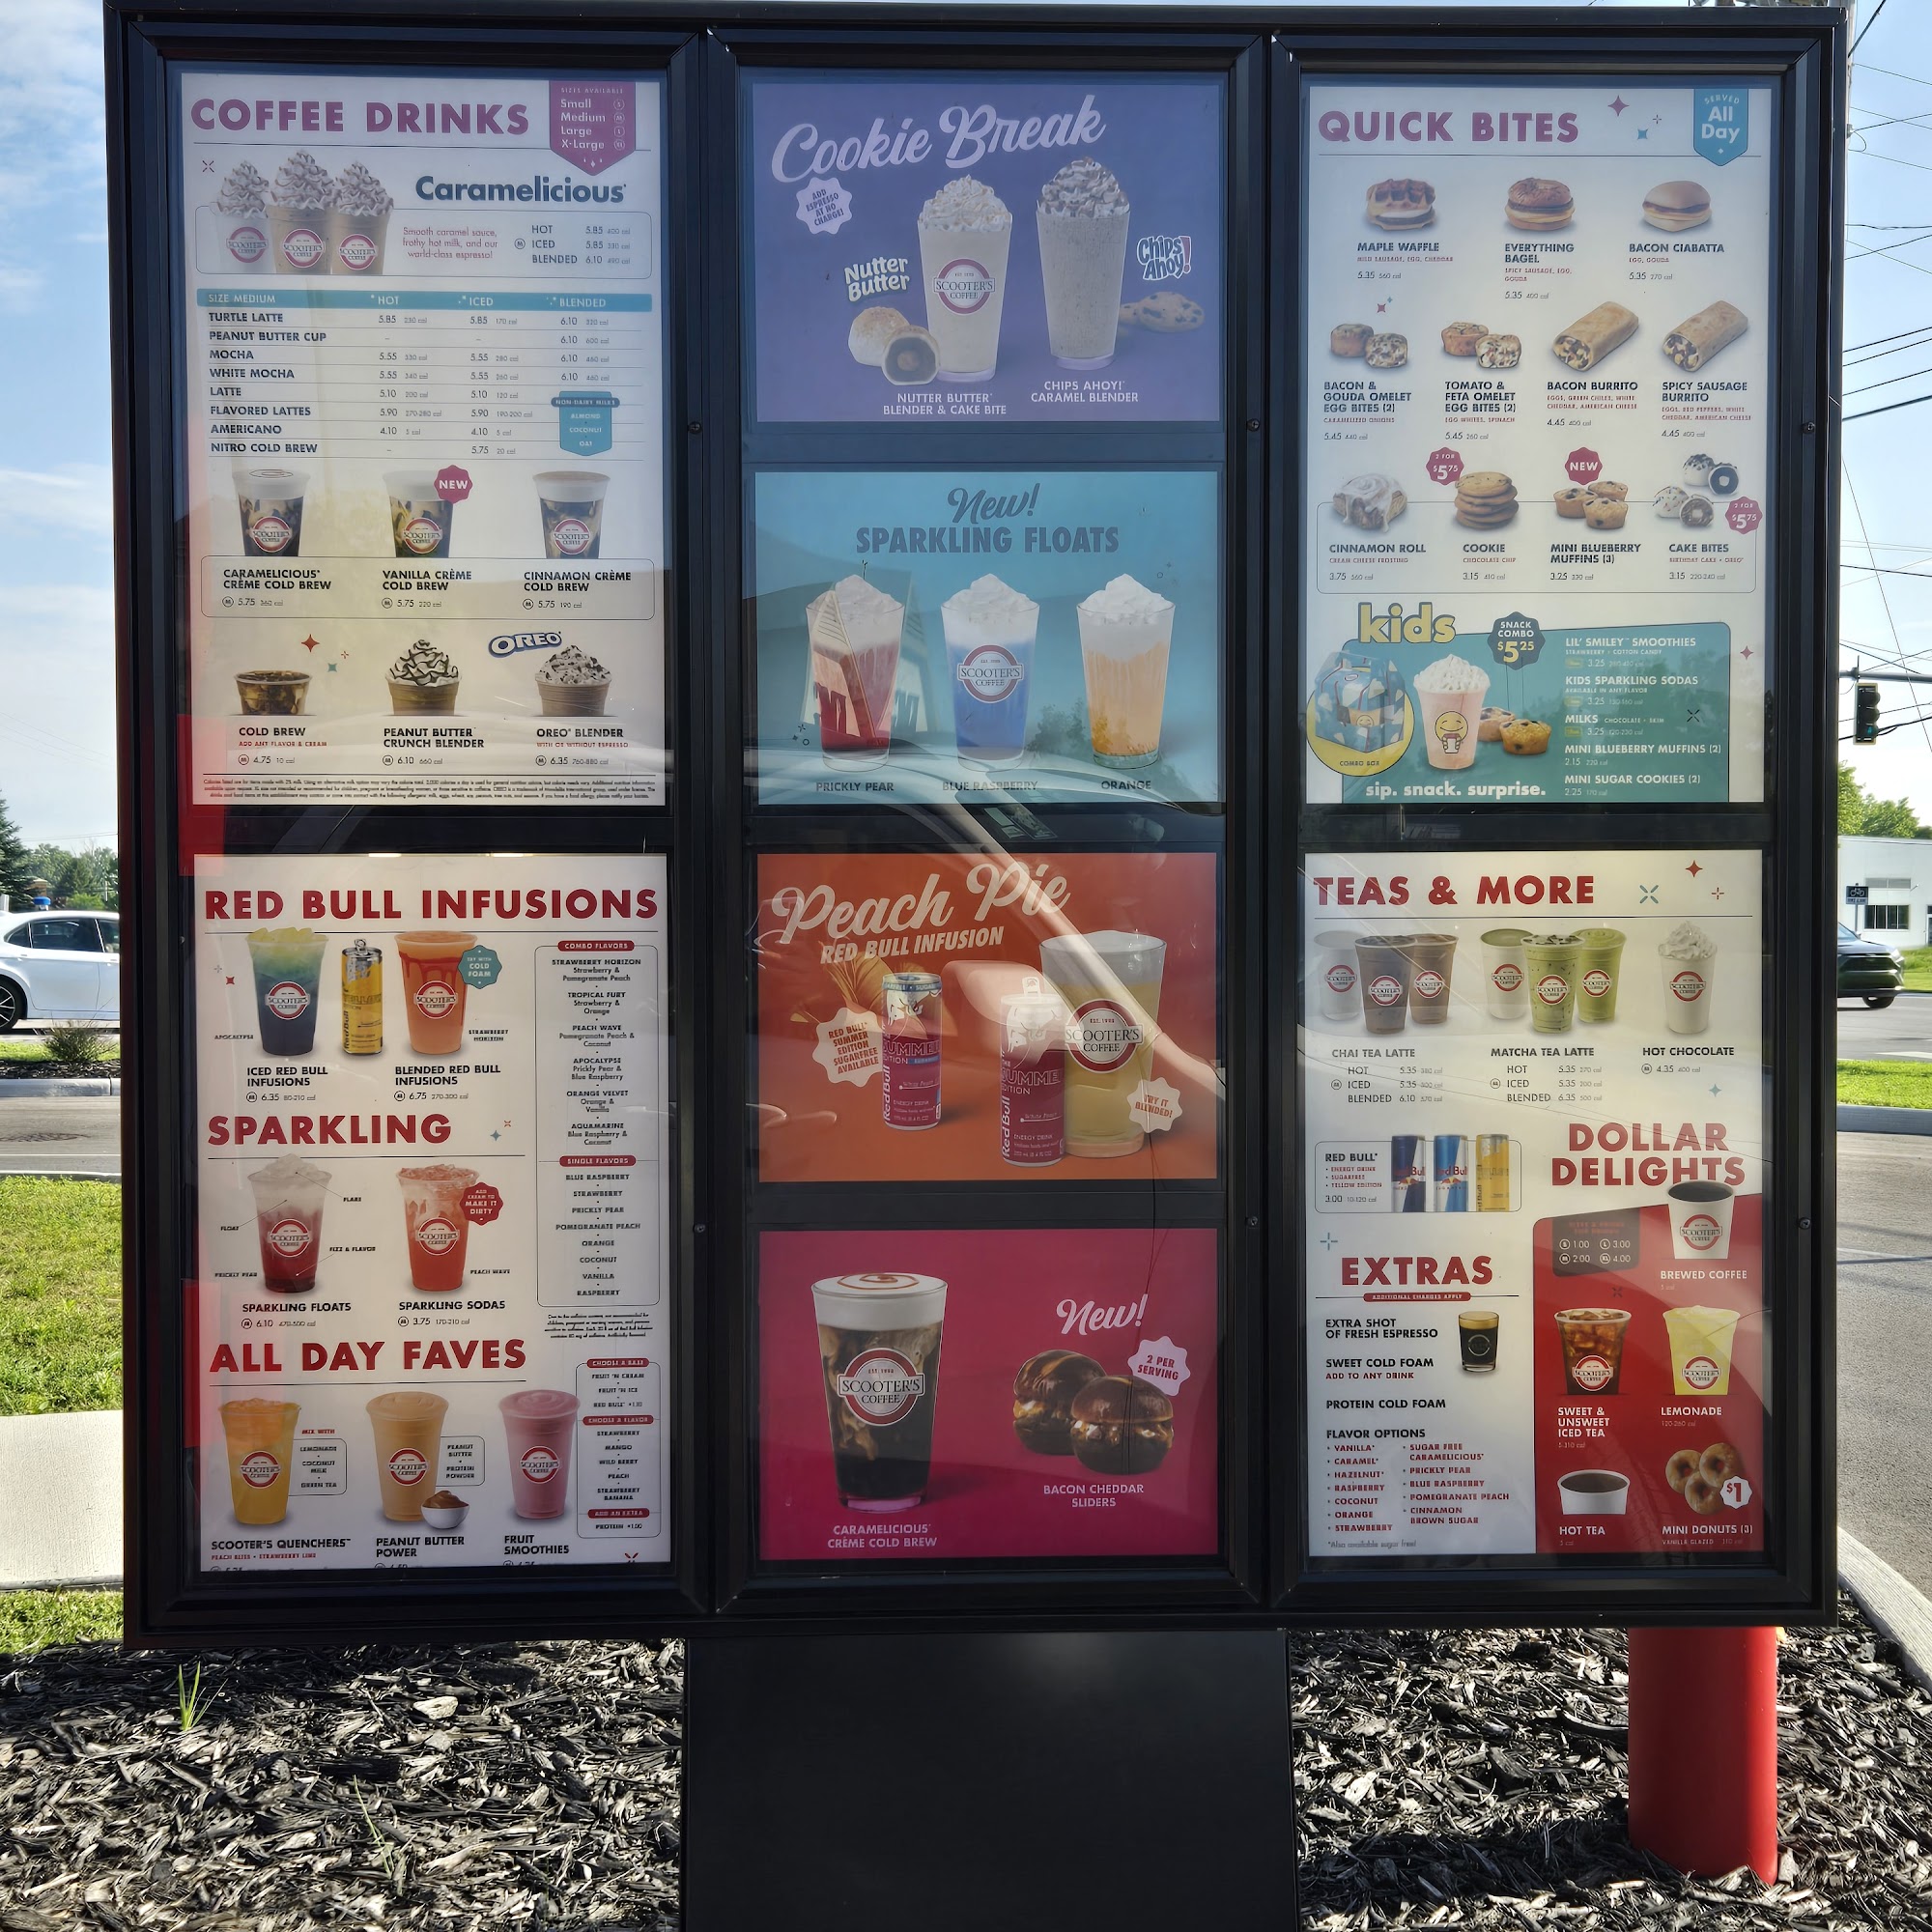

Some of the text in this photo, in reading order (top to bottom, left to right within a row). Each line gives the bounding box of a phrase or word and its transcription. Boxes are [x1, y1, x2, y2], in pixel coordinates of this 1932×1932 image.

[560, 99, 591, 109] Small
[190, 98, 529, 135] COFFEE DRINKS
[560, 112, 606, 124] Medium
[1708, 106, 1733, 123] All
[560, 126, 593, 137] Large
[1319, 111, 1579, 143] QUICK BITES
[772, 95, 1106, 183] Cookie Break
[1701, 124, 1740, 143] Day
[560, 139, 605, 151] X-Large
[531, 225, 604, 235] HOT 5.85
[531, 240, 604, 249] ICED 5.85
[1505, 243, 1575, 254] EVERYTHING
[1629, 243, 1724, 254] BACON CIABATTA
[532, 255, 603, 265] BLENDED 6.10
[1505, 254, 1540, 265] BAGEL
[844, 256, 908, 285] Nutter
[1629, 272, 1647, 281] 5.35
[847, 274, 911, 302] Butter
[934, 280, 994, 292] SCOOTER'S
[209, 294, 606, 308] SIZE MEDIUM HOT ICED BLENDED
[209, 313, 578, 327] TURTLE LATTE 5.85 5.85 6.10
[210, 368, 295, 380] WHITE MOCHA
[1043, 382, 1080, 391] CHIPS
[896, 393, 943, 404] NUTTER
[1031, 392, 1139, 403] CARAMEL BLENDER
[883, 405, 1007, 415] BLENDER & CAKE BITE
[211, 425, 398, 436] AMERICANO 4.10
[211, 442, 318, 454] NITRO COLD BREW
[1570, 462, 1598, 471] NEW
[439, 479, 468, 491] NEW
[947, 484, 1041, 525] New!
[856, 527, 1120, 554] SPARKLING FLOATS
[1463, 544, 1506, 554] COOKIE
[383, 570, 432, 581] VANILLA
[1463, 572, 1479, 581] 3.15
[383, 582, 449, 592] COLD BREW
[397, 599, 414, 609] 5.75
[1357, 602, 1457, 644] kids
[1500, 621, 1531, 630] SNACK
[1497, 630, 1535, 639] COMBO
[960, 668, 1021, 679] SCOOTER'S
[384, 727, 473, 738] PEANUT BUTTER
[383, 738, 484, 750] CRUNCH BLENDER
[1565, 744, 1721, 755] MINI BLUEBERRY MUFFINS (2)
[397, 756, 414, 765] 6.10
[816, 782, 895, 793] PRICKLY PEAR
[1101, 781, 1151, 790] ORANGE
[1365, 782, 1546, 800] sip. snack. surprise.
[1313, 875, 1595, 907] TEAS & MORE
[205, 889, 658, 921] RED BULL INFUSIONS
[771, 864, 1070, 945] Peach Pie
[821, 926, 1005, 965] RED BULL INFUSION
[1065, 1026, 1140, 1043] SCOOTER'S
[1083, 1042, 1121, 1053] COFFEE
[1491, 1047, 1595, 1058] MATCHA TEA LATTE
[1642, 1046, 1735, 1058] HOT CHOCOLATE
[246, 1066, 327, 1077] ICED RED BULL
[1656, 1065, 1674, 1074] 4.35
[246, 1077, 310, 1088] INFUSIONS
[589, 1073, 624, 1083] Raspberry
[261, 1094, 280, 1102] 6.35
[208, 1114, 452, 1147] SPARKLING
[1569, 1122, 1728, 1152] DOLLAR
[1551, 1157, 1746, 1187] DELIGHTS
[580, 1256, 617, 1264] COCONUT
[1341, 1257, 1493, 1287] EXTRAS
[1661, 1269, 1747, 1281] BREWED COFFEE
[398, 1300, 506, 1313] SPARKLING SODAS
[1056, 1294, 1149, 1336] New!
[412, 1318, 431, 1326] 3.75
[210, 1339, 526, 1374] ALL DAY FAVES
[1147, 1354, 1176, 1368] 2 PER
[1325, 1357, 1435, 1369] SWEET COLD FOAM
[1137, 1364, 1179, 1381] SERVING
[841, 1378, 921, 1395] SCOOTER'S
[861, 1394, 900, 1406] COFFEE
[1661, 1407, 1722, 1417] LEMONADE
[1043, 1484, 1144, 1495] BACON CHEDDAR
[1071, 1497, 1117, 1508] SLIDERS
[1334, 1497, 1378, 1506] COCONUT
[1559, 1526, 1605, 1536] HOT TEA
[376, 1536, 465, 1548] PEANUT BUTTER
[504, 1535, 534, 1546] FRUIT
[376, 1548, 417, 1559] POWER
[504, 1545, 570, 1556] SMOOTHIES
